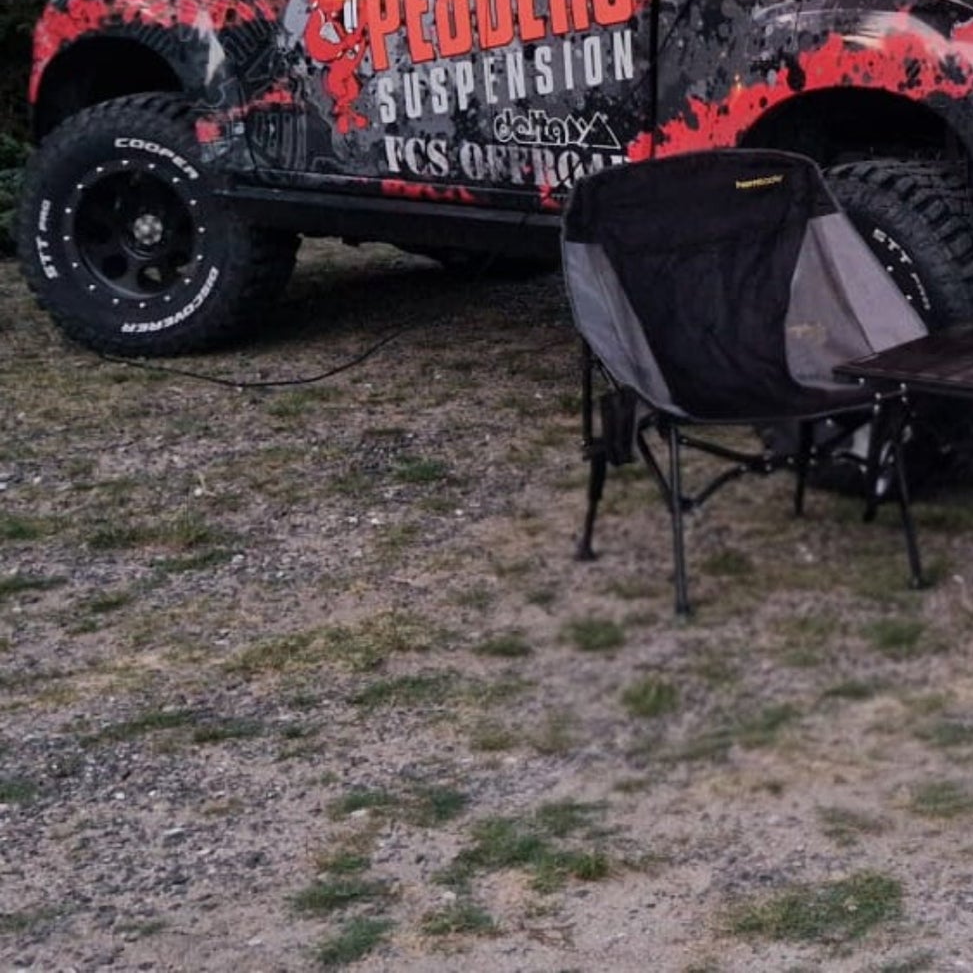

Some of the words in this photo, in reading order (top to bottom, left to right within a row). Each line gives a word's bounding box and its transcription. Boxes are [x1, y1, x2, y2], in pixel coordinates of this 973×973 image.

[378, 30, 634, 123] SUSPENSION
[114, 137, 199, 179] COOPER
[384, 136, 449, 177] FCS
[459, 139, 627, 189] OFFROA
[36, 235, 58, 279] STT
[120, 266, 220, 333] DISCOVERER
